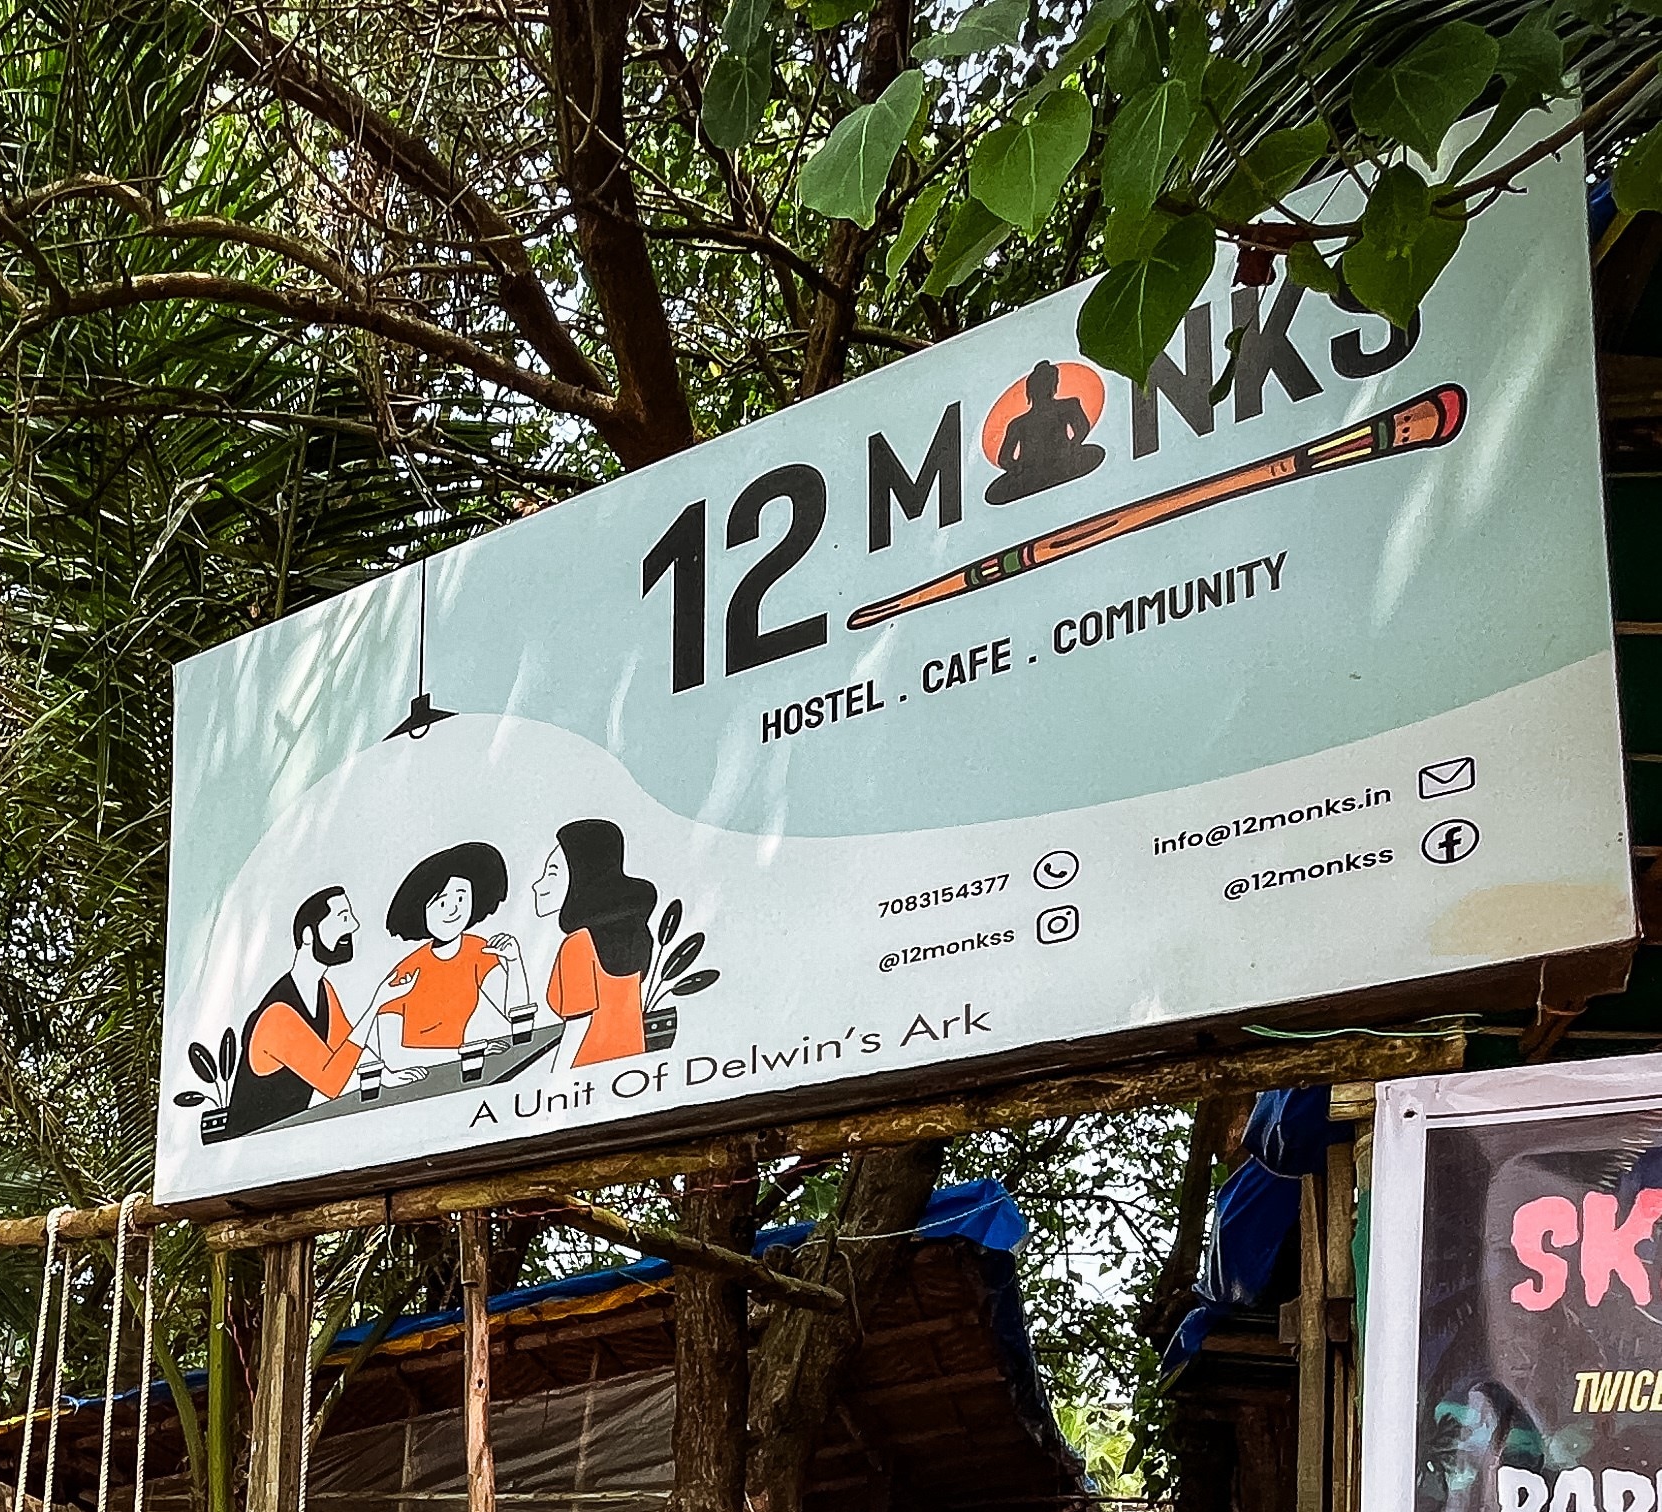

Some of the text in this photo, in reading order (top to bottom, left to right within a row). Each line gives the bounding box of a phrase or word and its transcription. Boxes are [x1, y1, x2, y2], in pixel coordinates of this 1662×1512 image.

[642, 462, 828, 694] 12
[761, 678, 885, 743] HOSTEL
[921, 639, 1013, 694] CAFE
[1052, 550, 1289, 655] COMMUNITY
[1152, 786, 1393, 857] info@12monks.in
[877, 873, 1011, 919] 7083154377
[1223, 846, 1394, 901] @12monkss
[878, 925, 1016, 973] @12monkss
[469, 1004, 993, 1128] A Unit Of Delwin's Ark
[1510, 1187, 1662, 1312] SK
